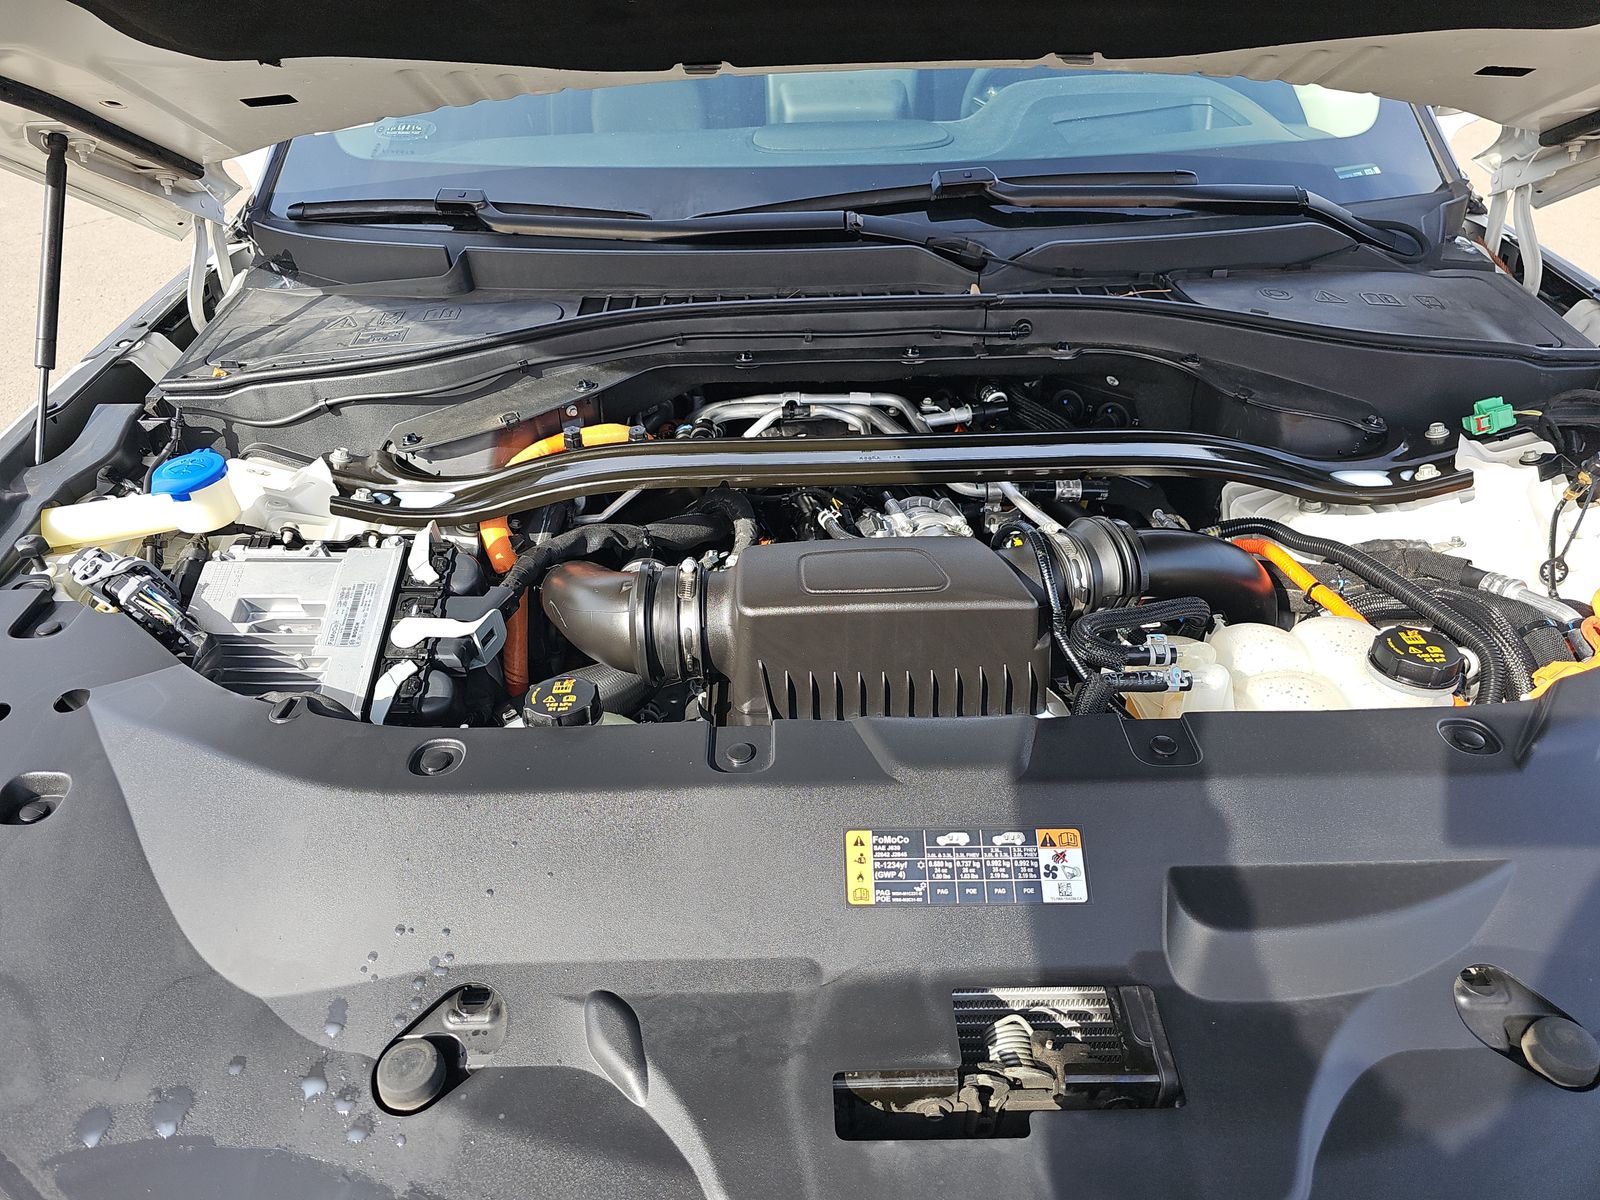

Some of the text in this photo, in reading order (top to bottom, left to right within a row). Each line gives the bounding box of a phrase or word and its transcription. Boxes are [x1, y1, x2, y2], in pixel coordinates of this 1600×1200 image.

[872, 836, 910, 844] FoMoCo
[874, 862, 908, 870] R-1234yf
[874, 870, 906, 879] (GWP 4)
